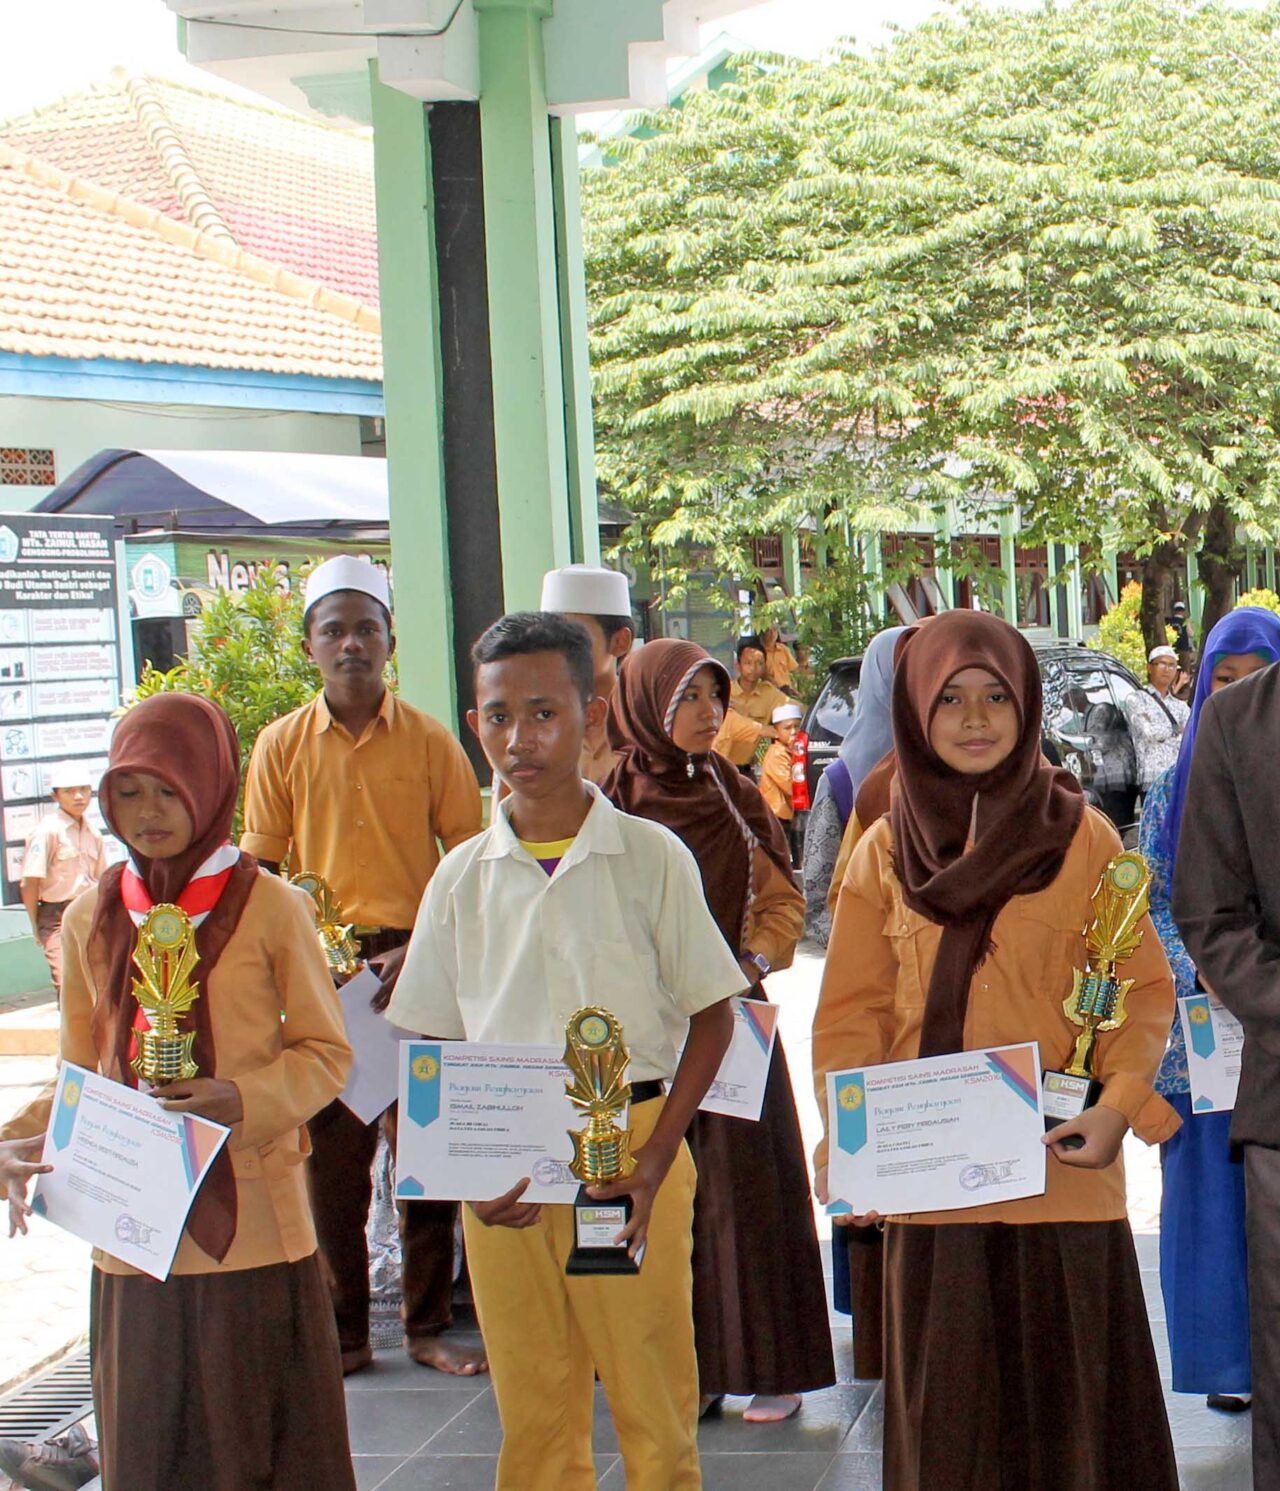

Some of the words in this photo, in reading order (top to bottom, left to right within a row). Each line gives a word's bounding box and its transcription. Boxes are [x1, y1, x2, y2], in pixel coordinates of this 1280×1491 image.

[44, 538, 77, 549] ZAINUL
[78, 539, 108, 549] HASAN
[71, 570, 95, 579] Santri
[96, 571, 112, 579] dan
[3, 580, 24, 590] Budi
[25, 580, 52, 589] Utama
[53, 580, 78, 589] Santri
[53, 591, 69, 600] dan
[866, 1075, 906, 1086] KOMPETISI
[907, 1072, 931, 1080] SAINS
[932, 1065, 980, 1076] MADRASAH
[1061, 1080, 1085, 1091] KSM
[595, 1210, 621, 1218] KSM
